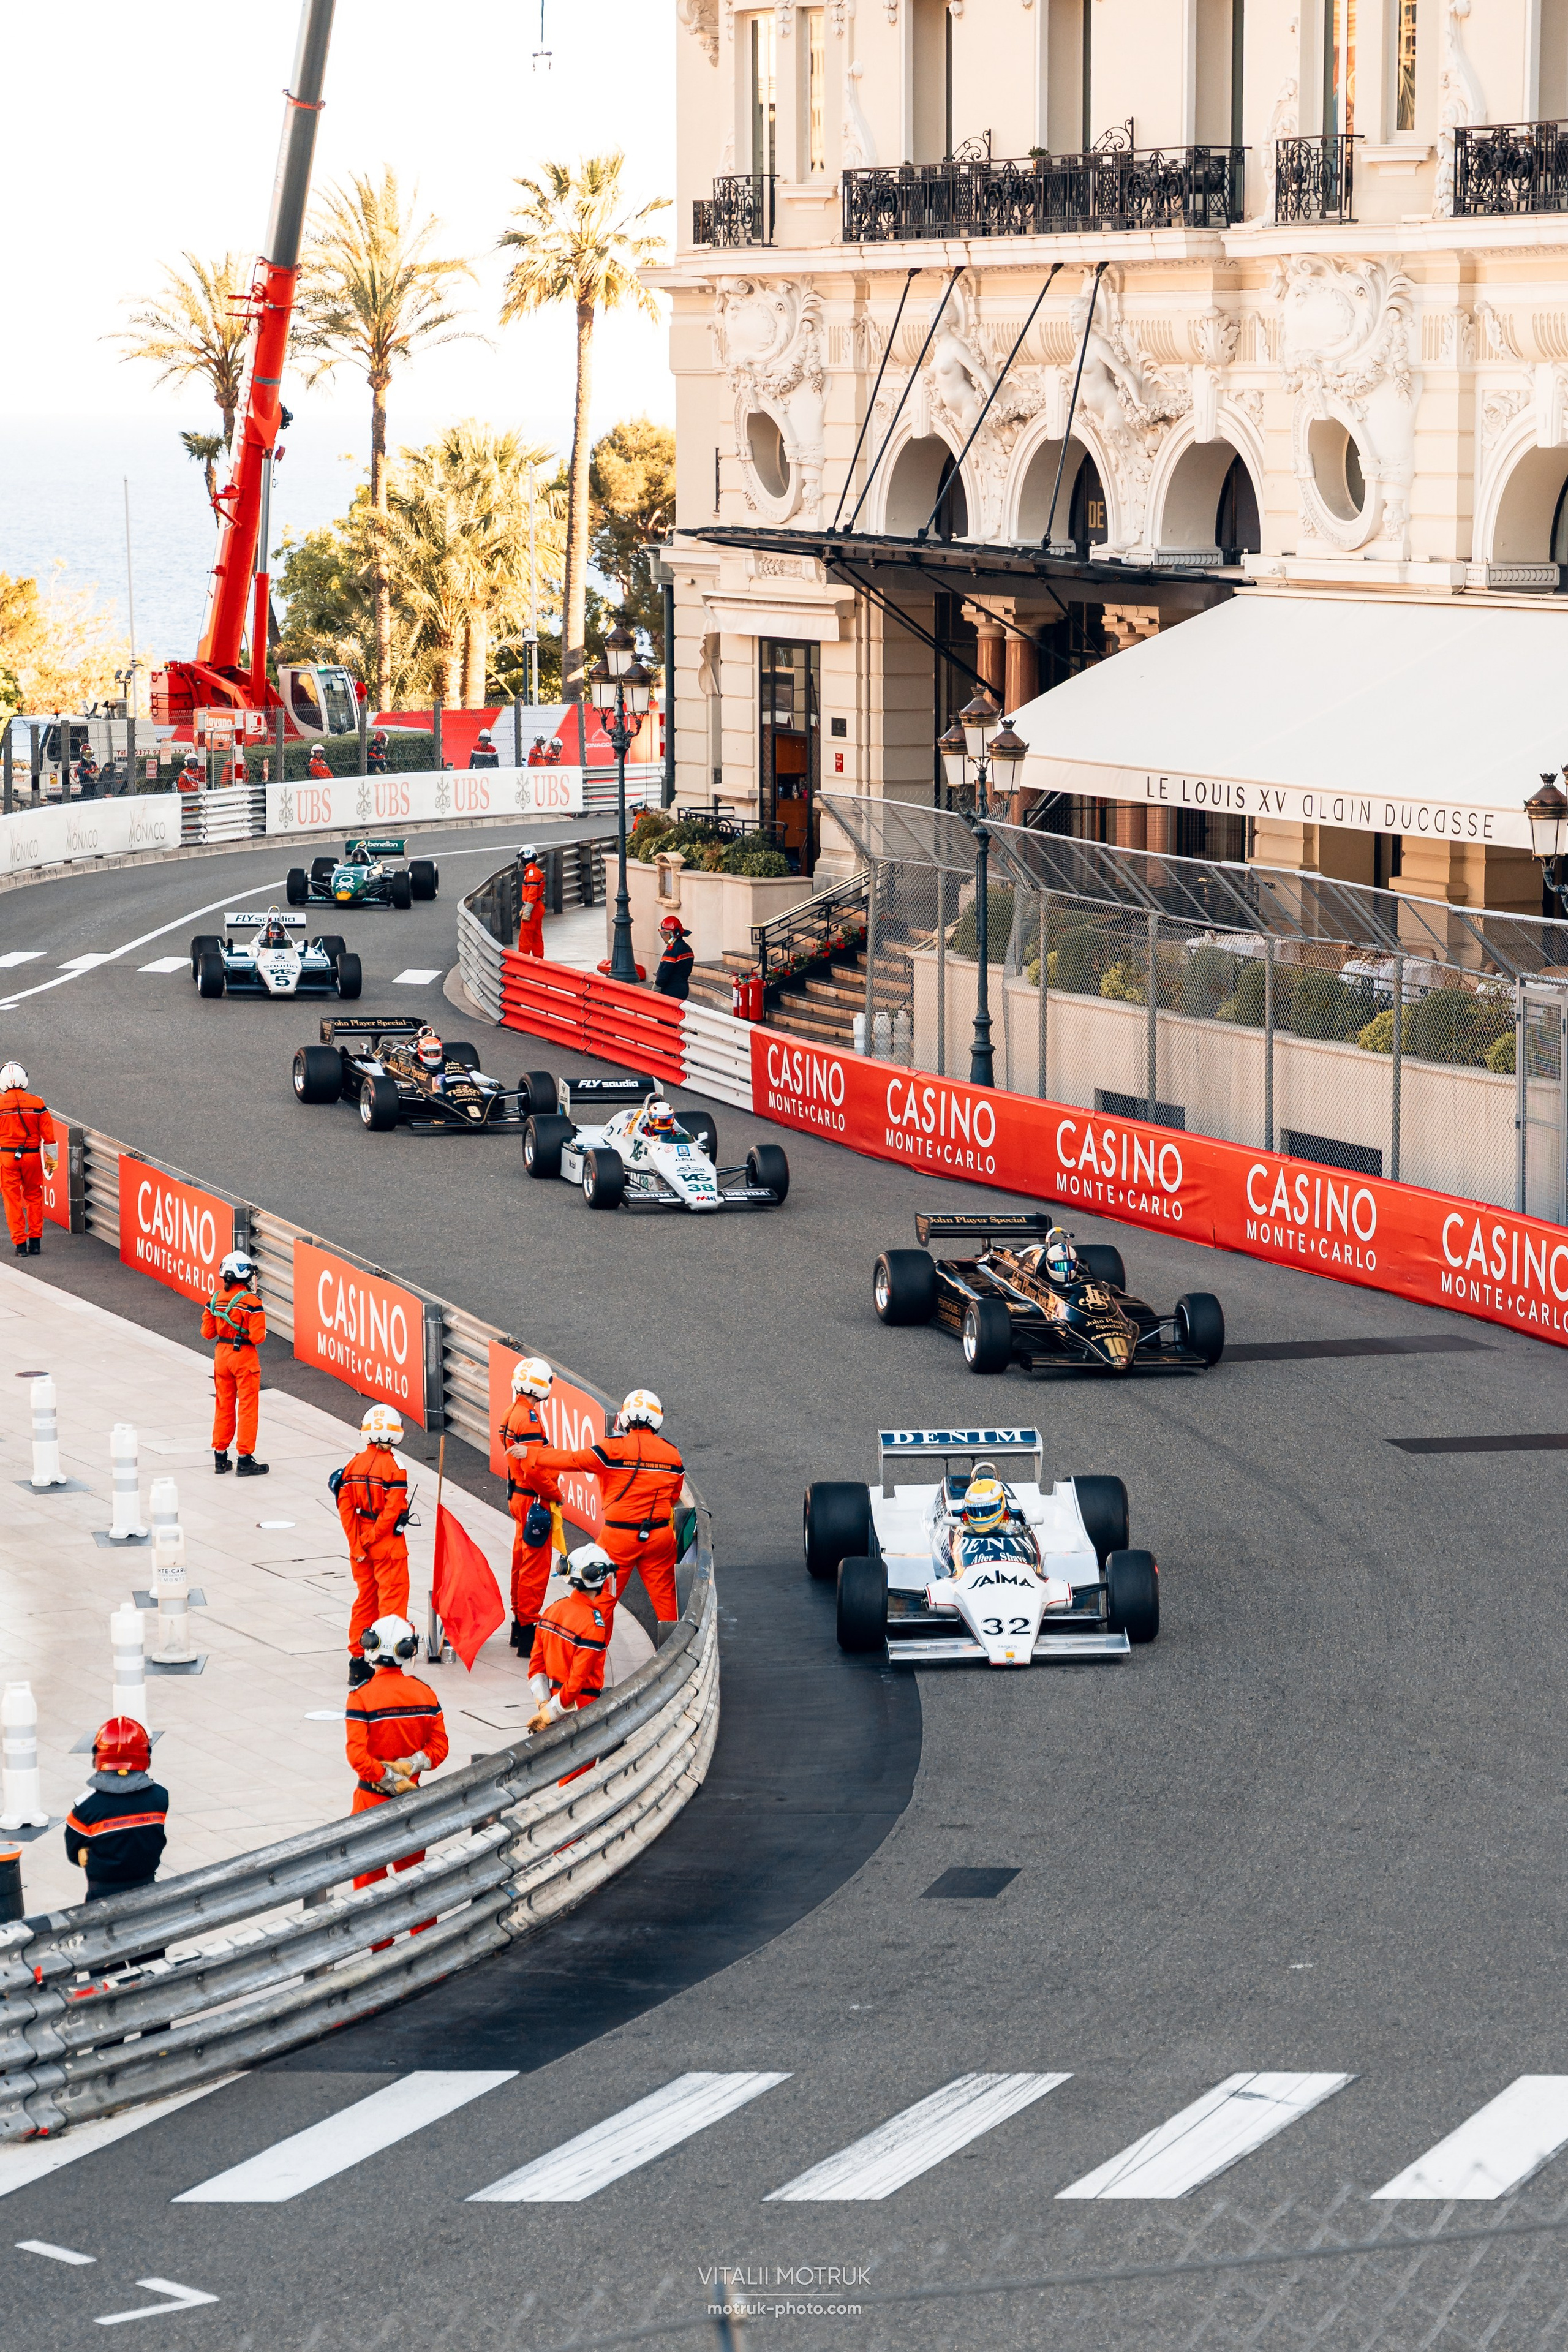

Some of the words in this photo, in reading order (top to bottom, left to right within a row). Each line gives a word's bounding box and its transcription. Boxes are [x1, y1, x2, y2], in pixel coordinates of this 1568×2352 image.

[1088, 500, 1104, 528] DE
[206, 712, 232, 728] iovano
[374, 782, 410, 818] UBS
[453, 777, 490, 812] UBS
[533, 774, 570, 807] UBS
[1147, 775, 1169, 800] LE
[1182, 780, 1245, 810] LOUIS
[1259, 789, 1287, 813] XV
[296, 788, 331, 825] UBS
[66, 829, 98, 853] MONACO
[129, 821, 166, 843] MONACO
[10, 839, 39, 863] MONACO
[274, 976, 290, 987] 5
[578, 1079, 602, 1088] FLY
[601, 1079, 639, 1088] saudia
[767, 1043, 845, 1107] CASINO
[445, 1088, 481, 1098] TISSOT
[467, 1105, 482, 1118] 9
[768, 1090, 804, 1118] MONTE
[810, 1104, 845, 1132] CARLO
[886, 1078, 996, 1148] CASINO
[886, 1128, 933, 1159] MONTE
[944, 1144, 996, 1175] CARLO
[1056, 1119, 1183, 1193] CASINO
[677, 1173, 712, 1182] TAG
[687, 1183, 716, 1192] 38
[1056, 1172, 1115, 1204] MONTE
[1127, 1189, 1183, 1221] CARLO
[1246, 1163, 1377, 1242] CASINO
[137, 1180, 216, 1265] CASINO
[1246, 1219, 1306, 1254] MONTE
[1319, 1238, 1377, 1272] CARLO
[1442, 1212, 1568, 1302] CASINO
[136, 1237, 173, 1275] MONTE
[178, 1259, 215, 1295] CARLO
[1441, 1270, 1503, 1311] MONTE
[318, 1270, 408, 1365] CASINO
[1085, 1318, 1104, 1327] John
[1091, 1331, 1132, 1341] GOODYEAR
[1103, 1336, 1129, 1358] 10
[317, 1331, 356, 1374] MONTE
[364, 1357, 409, 1400] CARLO
[518, 1368, 529, 1381] S
[633, 1396, 644, 1408] S
[373, 1418, 384, 1431] S
[892, 1430, 1025, 1444] DENIM
[557, 1474, 597, 1521] CARLO
[953, 1536, 1037, 1555] DENIM
[971, 1553, 994, 1564] After
[1000, 1551, 1028, 1564] Shave
[967, 1570, 1035, 1590] SAIMA
[981, 1617, 1032, 1635] 32
